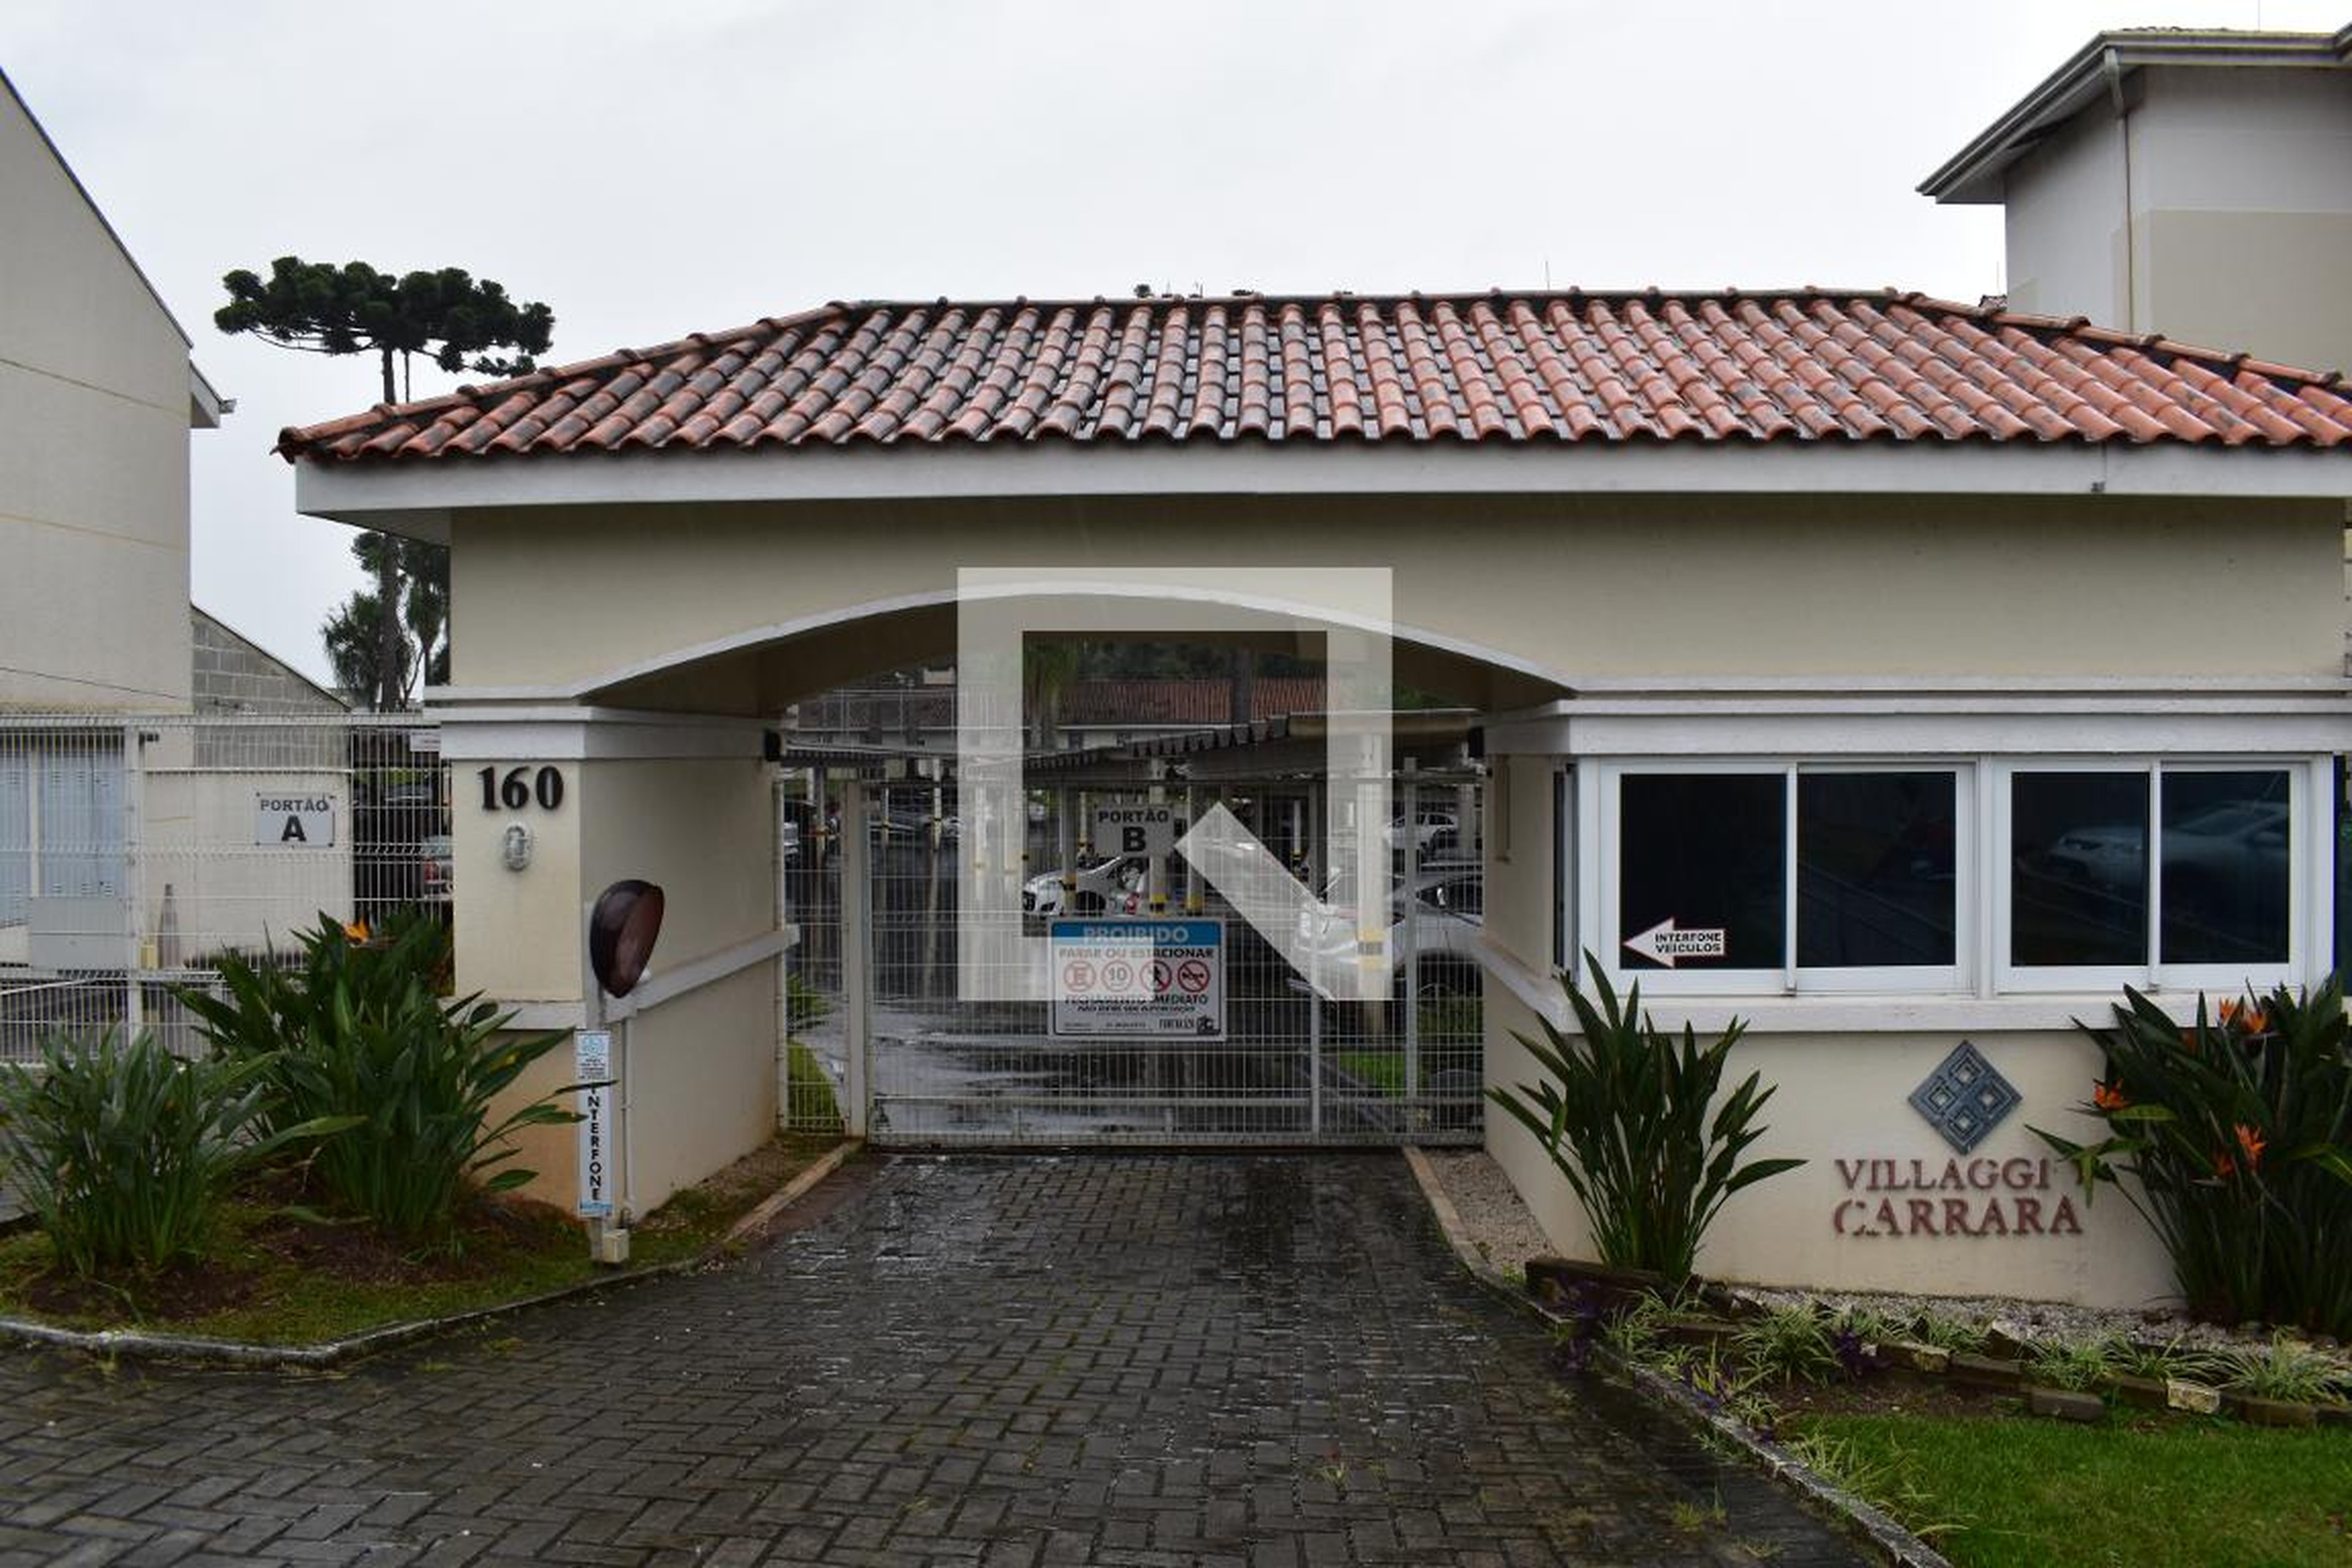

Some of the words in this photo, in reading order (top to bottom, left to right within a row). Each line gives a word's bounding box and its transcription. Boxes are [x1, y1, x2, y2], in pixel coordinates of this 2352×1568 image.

[478, 765, 565, 813] 160
[260, 797, 330, 812] PORTÃO
[1098, 809, 1169, 823] PORTÃO
[281, 815, 307, 842] A
[1123, 826, 1146, 852] B
[1083, 925, 1189, 943] PROIBIDO
[1655, 932, 1721, 942] INTERFONE
[1833, 1196, 2084, 1237] CARRARA
